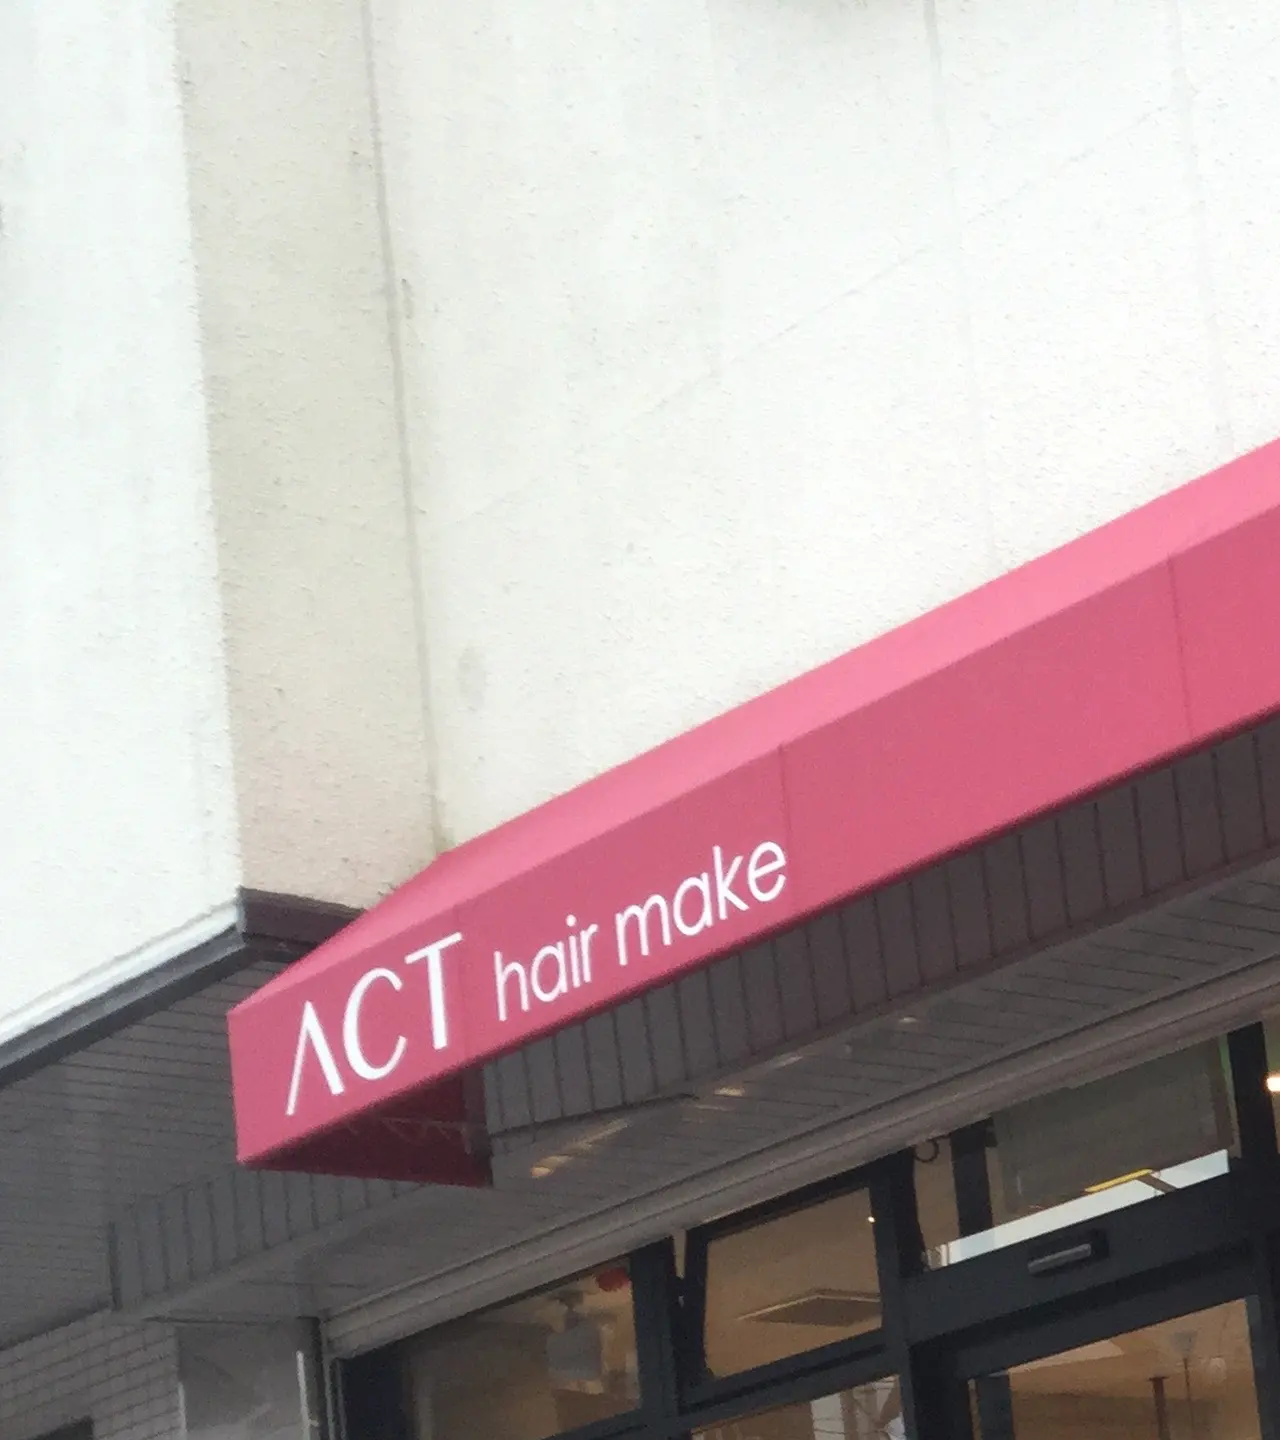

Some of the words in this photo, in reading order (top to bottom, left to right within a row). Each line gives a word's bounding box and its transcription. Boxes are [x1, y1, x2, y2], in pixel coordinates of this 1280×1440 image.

[286, 932, 462, 1116] ACT
[494, 915, 598, 1021] hair
[616, 840, 787, 966] make
